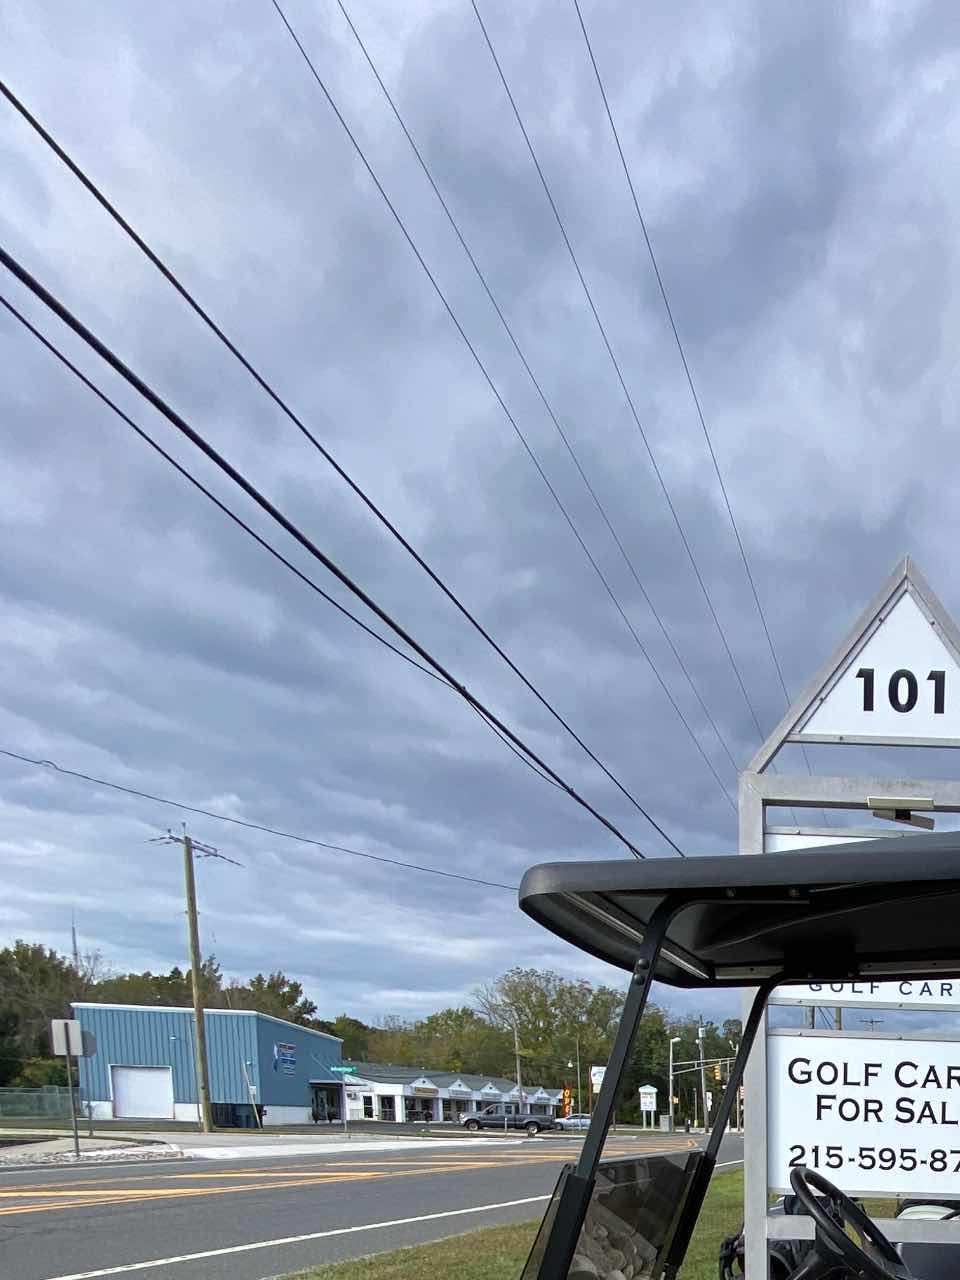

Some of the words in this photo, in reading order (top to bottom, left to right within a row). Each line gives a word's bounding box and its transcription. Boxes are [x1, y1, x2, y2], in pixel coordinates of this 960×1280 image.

[855, 667, 946, 715] 101
[788, 1057, 882, 1087] GOLF
[815, 1094, 883, 1123] FOR
